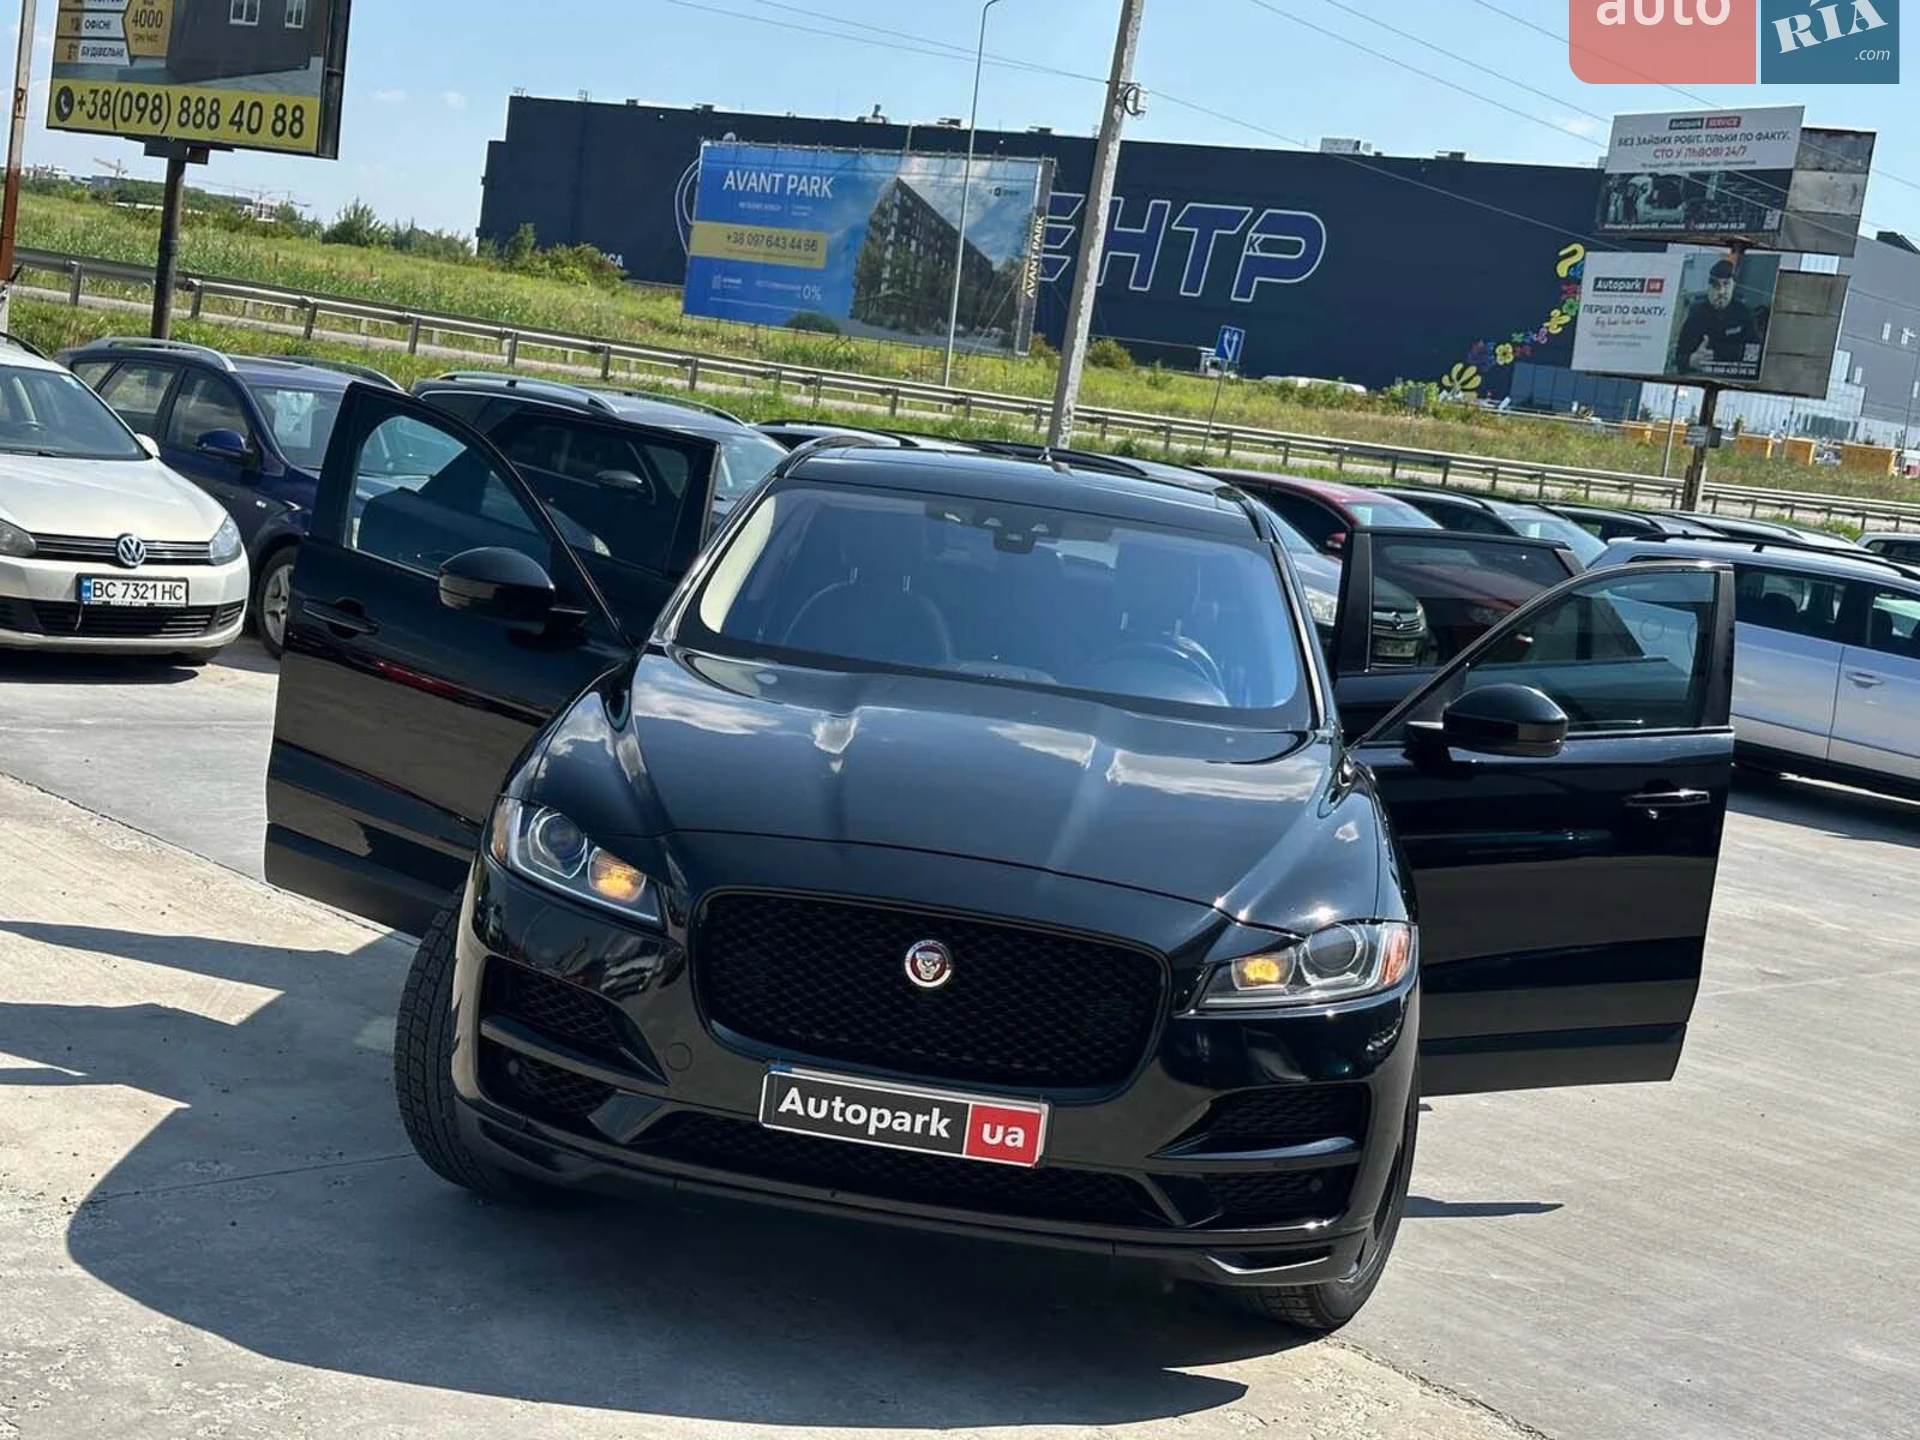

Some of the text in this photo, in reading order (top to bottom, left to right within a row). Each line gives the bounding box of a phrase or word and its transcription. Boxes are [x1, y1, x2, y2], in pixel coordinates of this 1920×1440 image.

[131, 9, 163, 28] 4000
[77, 86, 304, 139] +38(098) 888 40 88
[1653, 147, 1674, 159] СТО
[722, 169, 835, 199] AVANT PARK
[1026, 215, 1045, 298] AVANT PARK
[1596, 277, 1642, 290] Autopark
[1583, 303, 1613, 314] ПЕРШІ
[1614, 304, 1630, 315] ПО
[93, 581, 183, 601] BC 7321 HC
[778, 1087, 1025, 1148] Autopark ua
